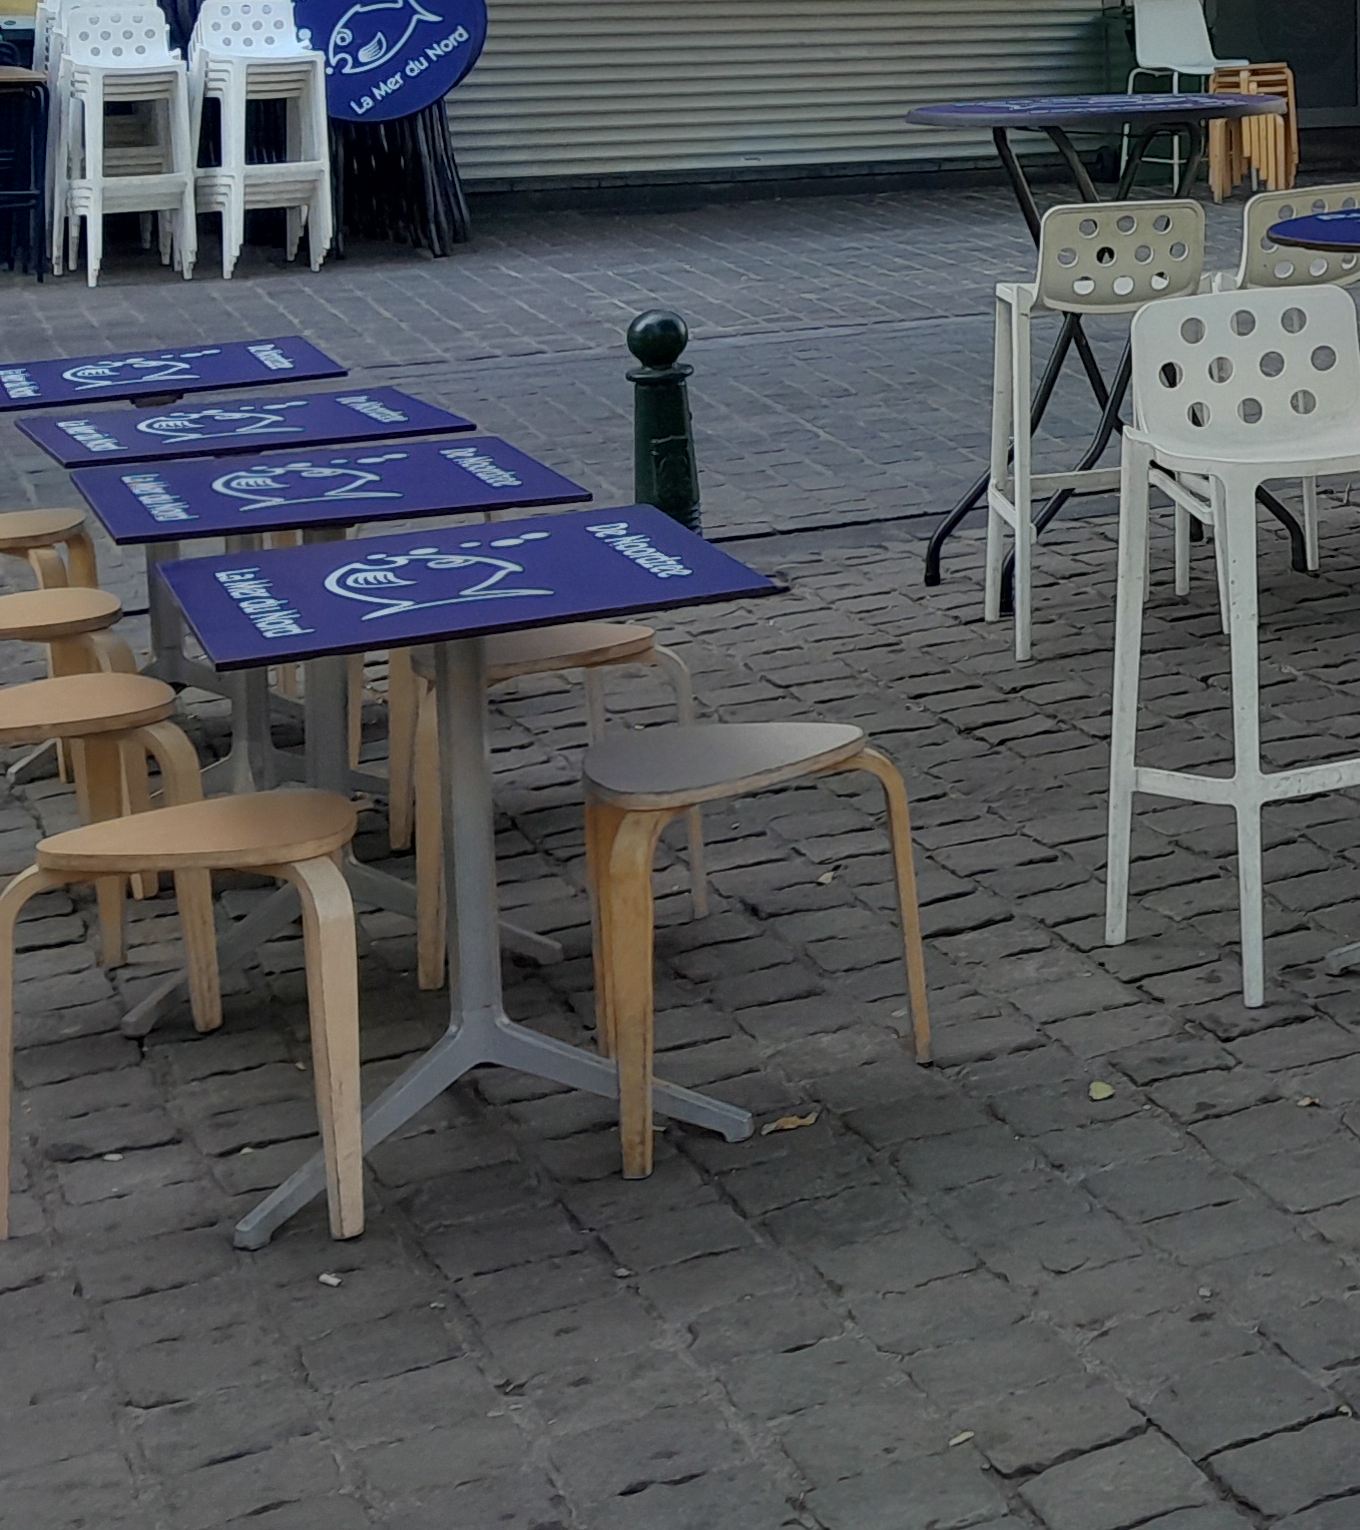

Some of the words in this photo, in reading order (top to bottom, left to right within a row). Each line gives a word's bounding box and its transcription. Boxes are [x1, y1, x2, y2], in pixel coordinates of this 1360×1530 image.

[350, 96, 374, 115] La
[371, 73, 404, 101] Mer
[405, 55, 429, 77] du
[425, 26, 469, 62] Nord
[587, 523, 628, 537] De
[605, 535, 692, 577] Noordzee
[216, 568, 259, 582] La
[224, 580, 272, 598] Mer
[240, 599, 287, 613] du
[250, 610, 314, 637] Nord
